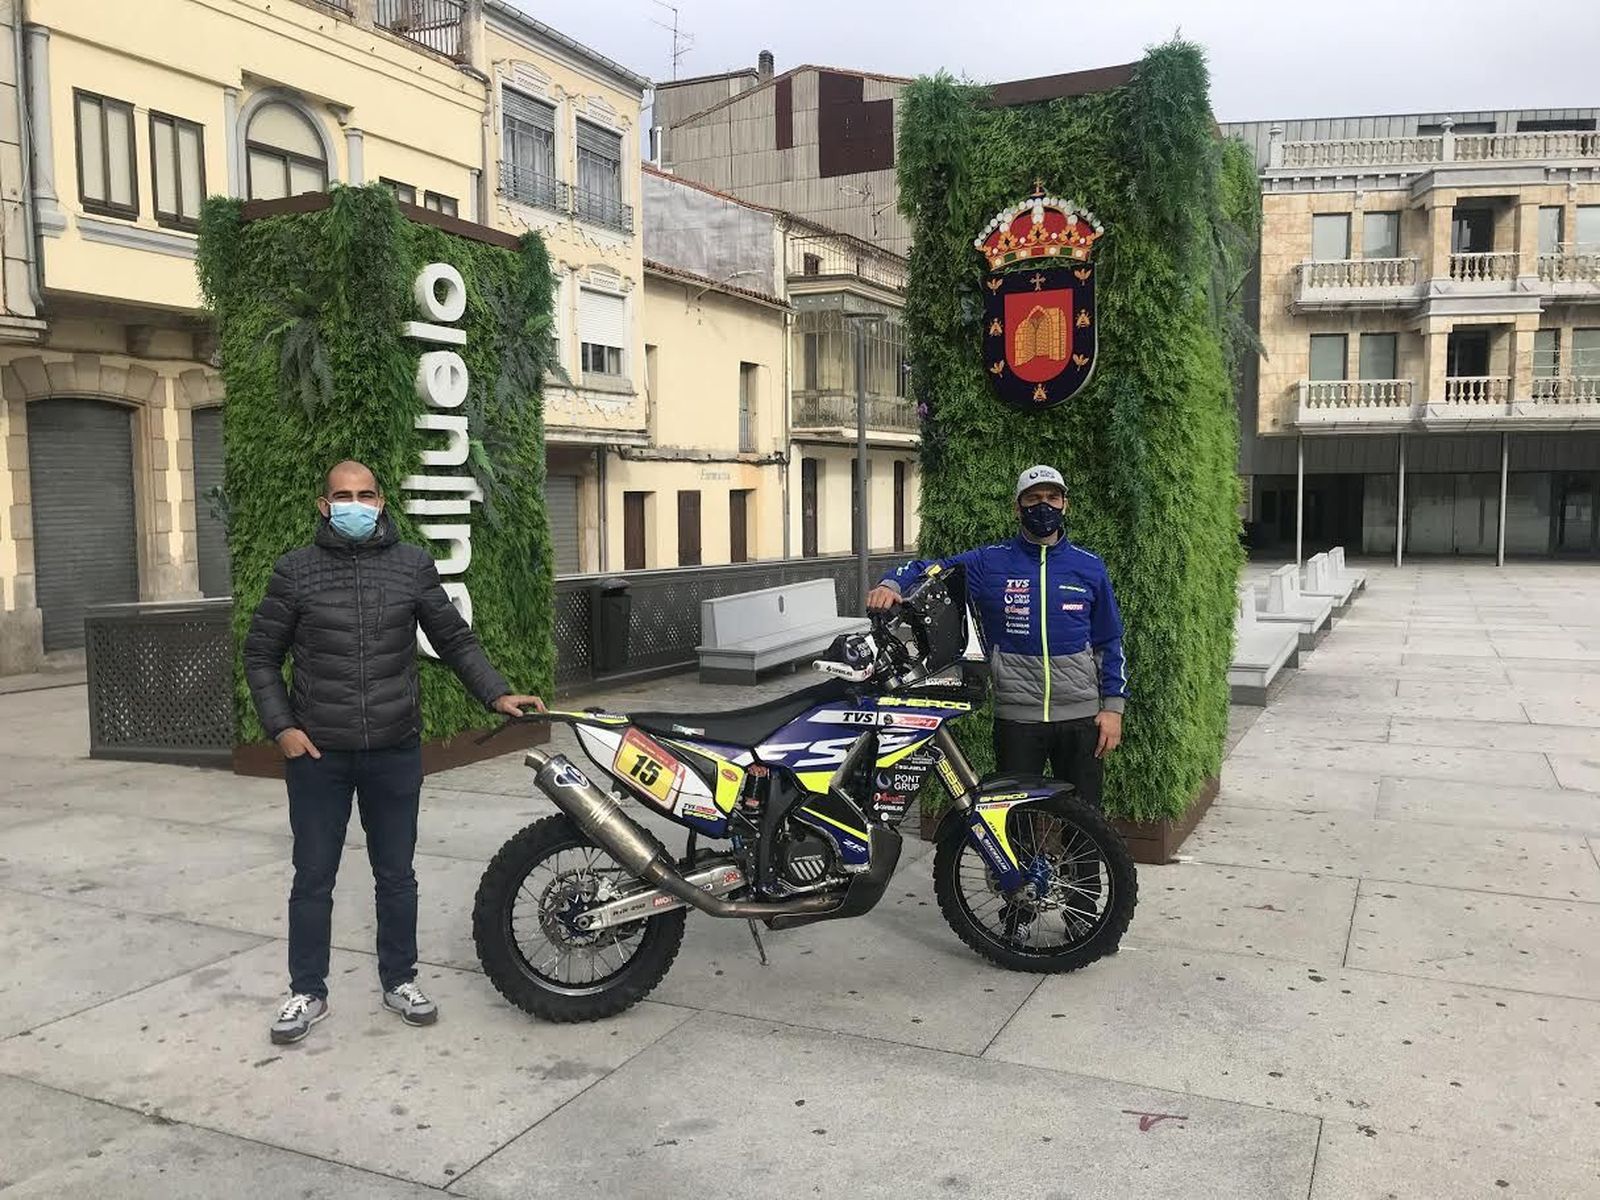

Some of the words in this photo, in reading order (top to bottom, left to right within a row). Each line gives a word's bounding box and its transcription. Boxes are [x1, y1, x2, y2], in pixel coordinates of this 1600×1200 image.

[1006, 579, 1030, 588] TVS
[877, 696, 971, 711] SHERCO
[842, 712, 874, 723] TVS
[630, 754, 663, 787] 15
[894, 774, 920, 783] PONT
[893, 782, 920, 791] GRUP
[979, 792, 1028, 802] SHERCO
